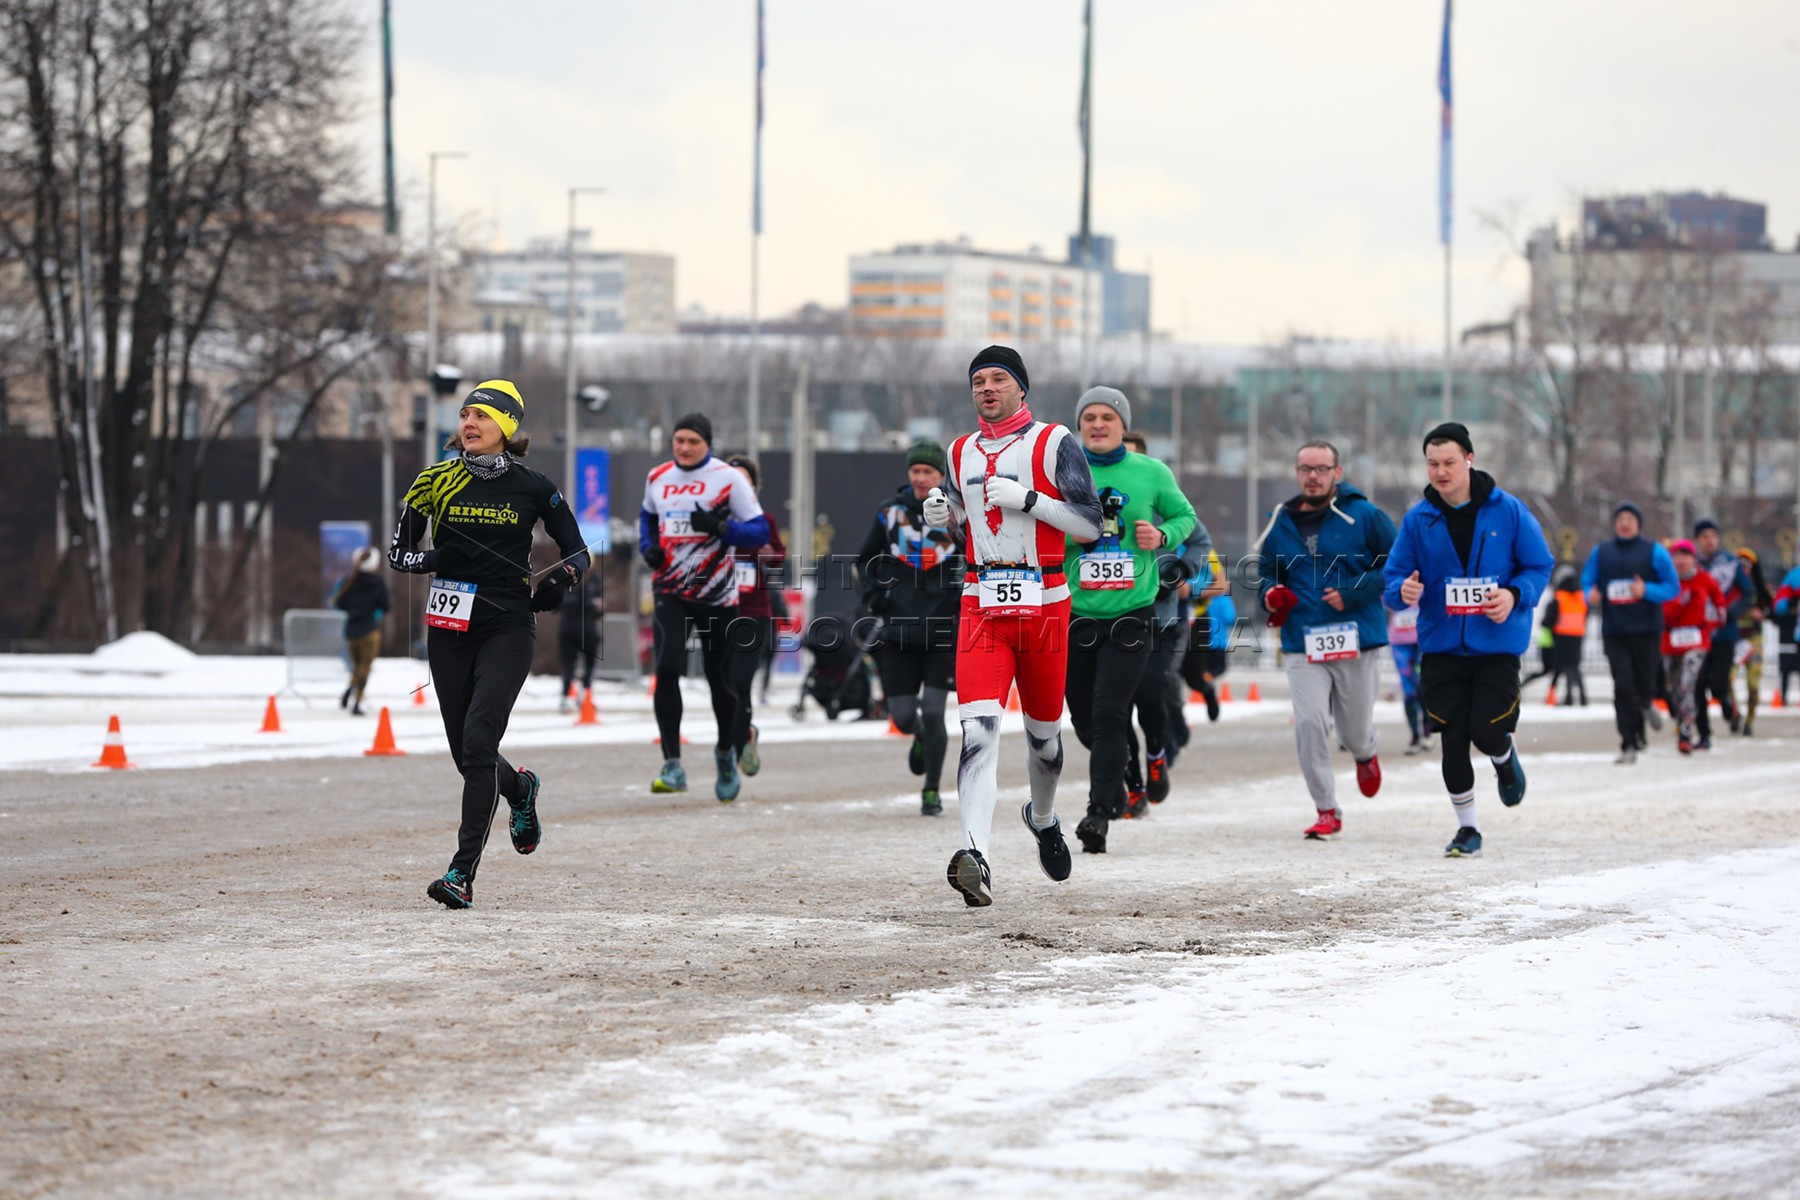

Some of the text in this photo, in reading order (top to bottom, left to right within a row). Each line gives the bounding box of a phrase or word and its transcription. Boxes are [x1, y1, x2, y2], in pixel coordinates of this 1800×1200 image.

[1090, 562, 1123, 579] 358
[996, 583, 1022, 603] 55
[430, 592, 460, 615] 499
[1315, 634, 1346, 652] 339
